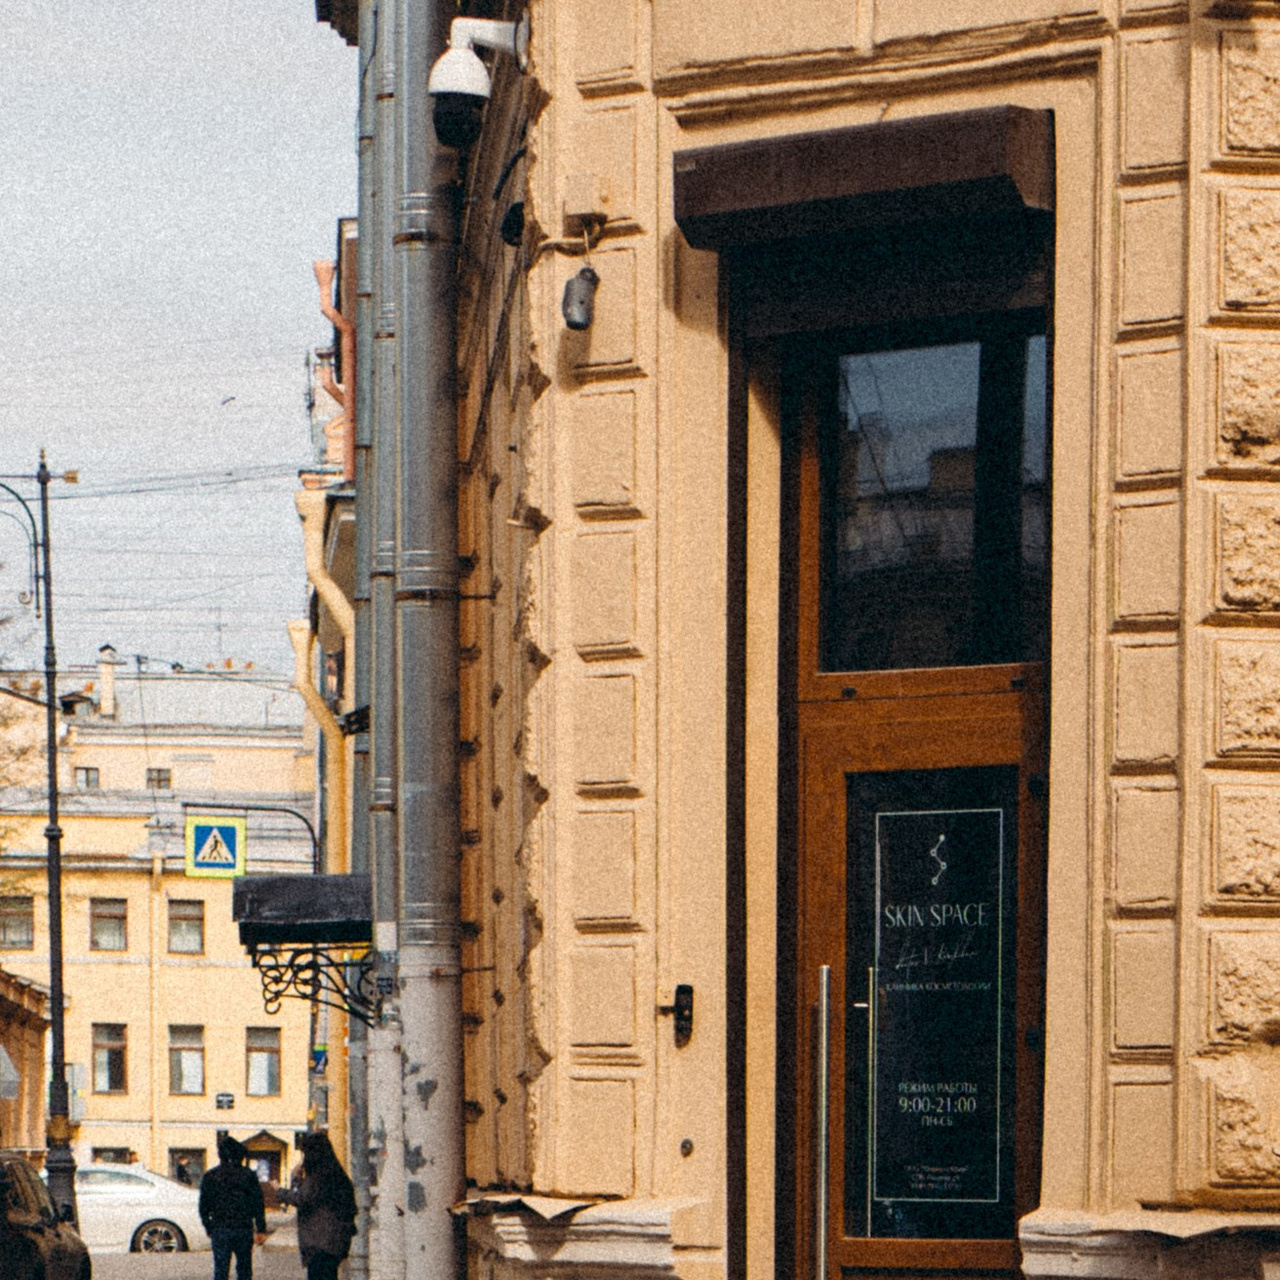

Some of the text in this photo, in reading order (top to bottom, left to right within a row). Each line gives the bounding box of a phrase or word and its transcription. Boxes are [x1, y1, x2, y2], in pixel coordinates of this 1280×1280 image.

[885, 903, 990, 928] SKIN SPACE
[898, 1083, 978, 1094] РЕЖИМ РАБОТЫ
[899, 1097, 977, 1112] 9:00-21:00
